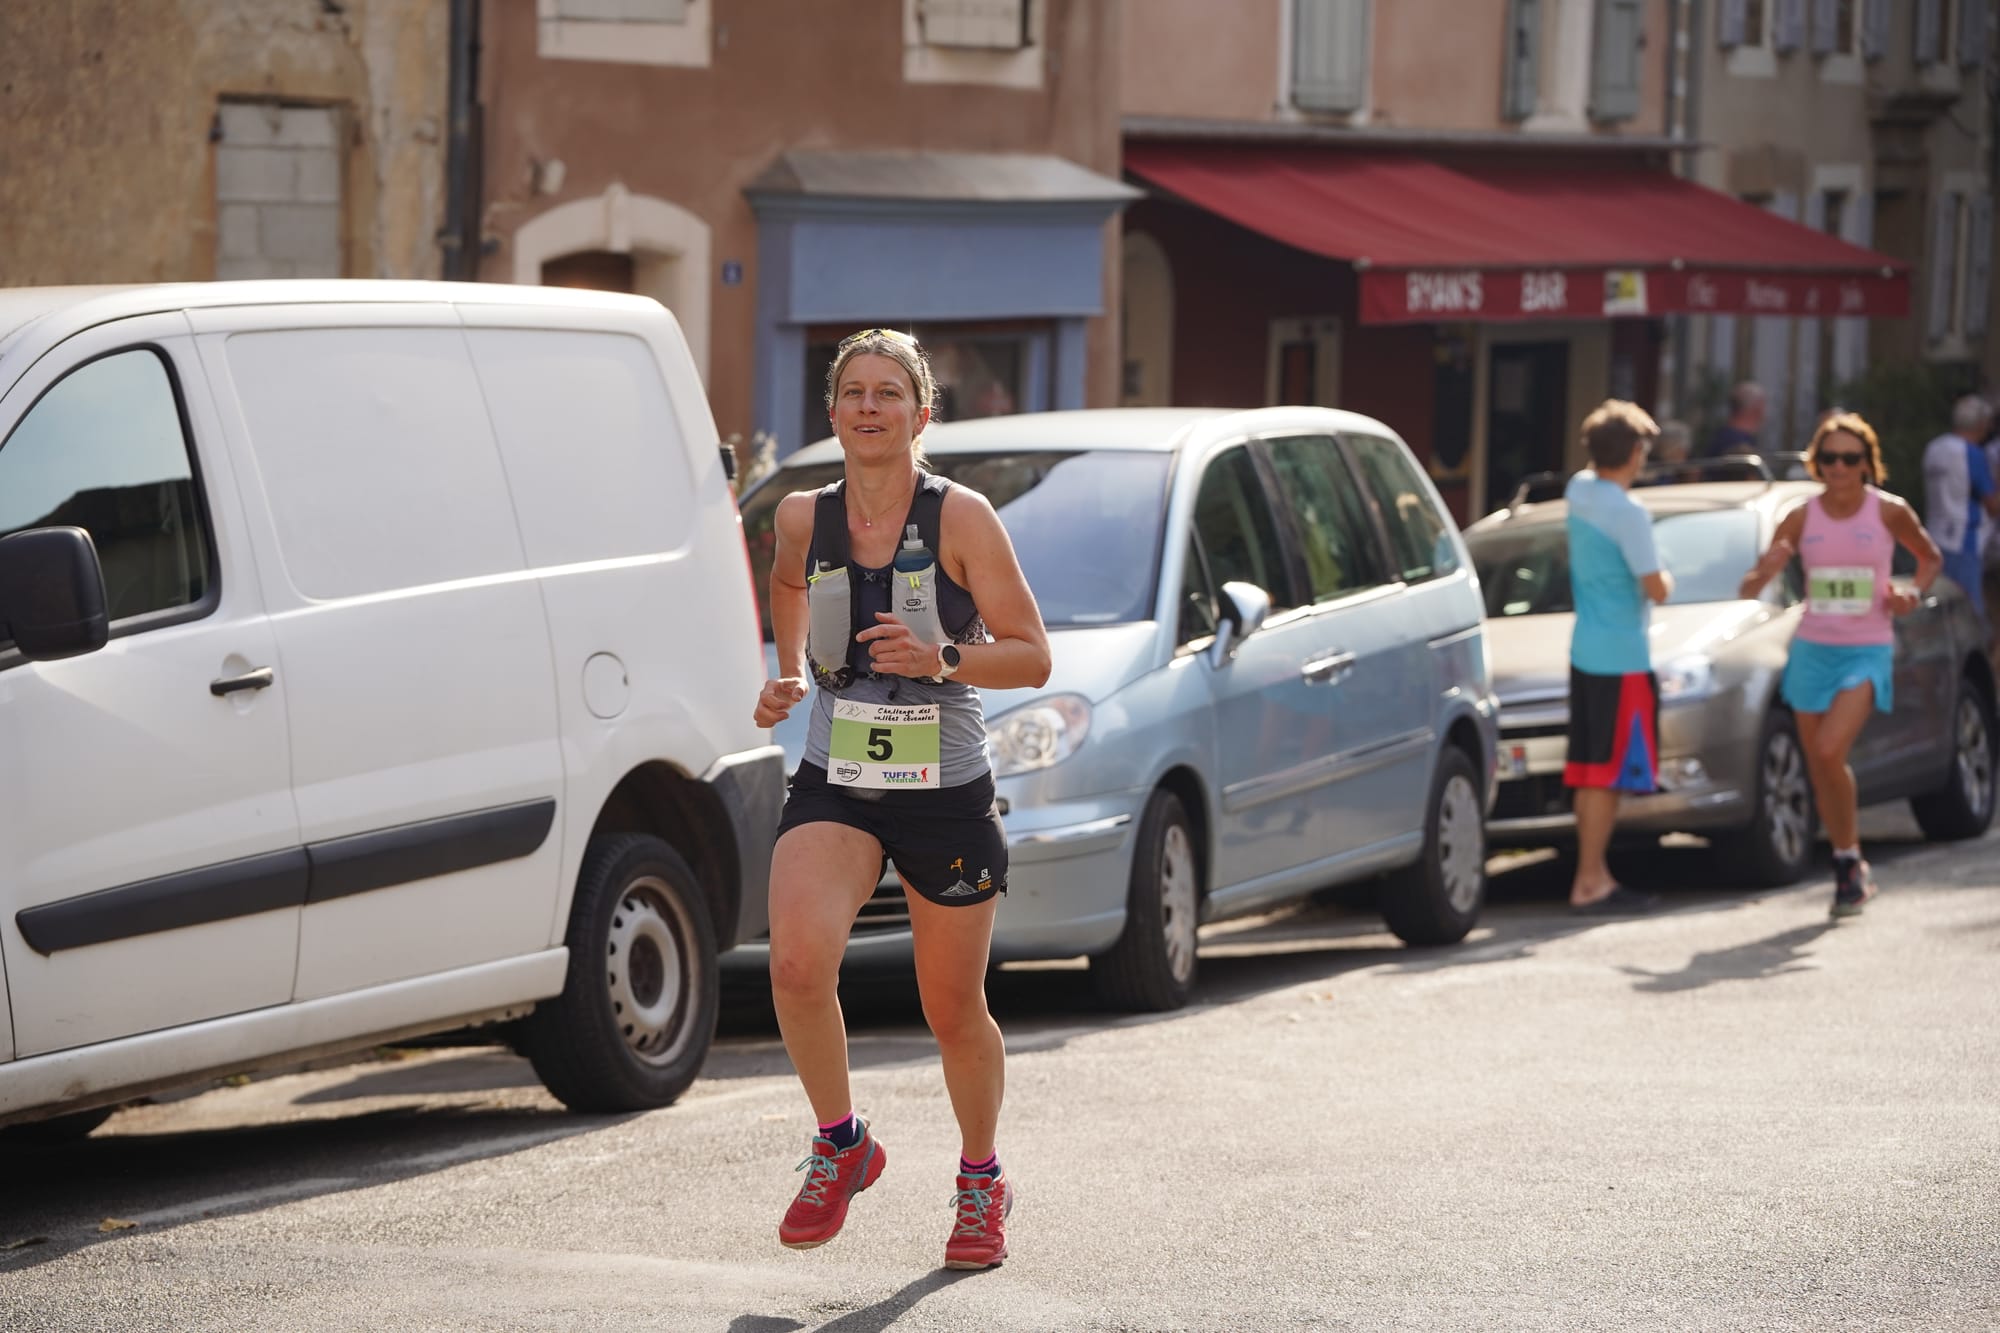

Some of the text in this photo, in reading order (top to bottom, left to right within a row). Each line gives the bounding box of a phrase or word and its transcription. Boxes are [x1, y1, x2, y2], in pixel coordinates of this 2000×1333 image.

[1521, 271, 1567, 311] BAR
[1826, 581, 1855, 598] 18
[877, 707, 915, 717] Challenge
[866, 727, 894, 762] 5
[882, 771, 918, 779] TUFF'S
